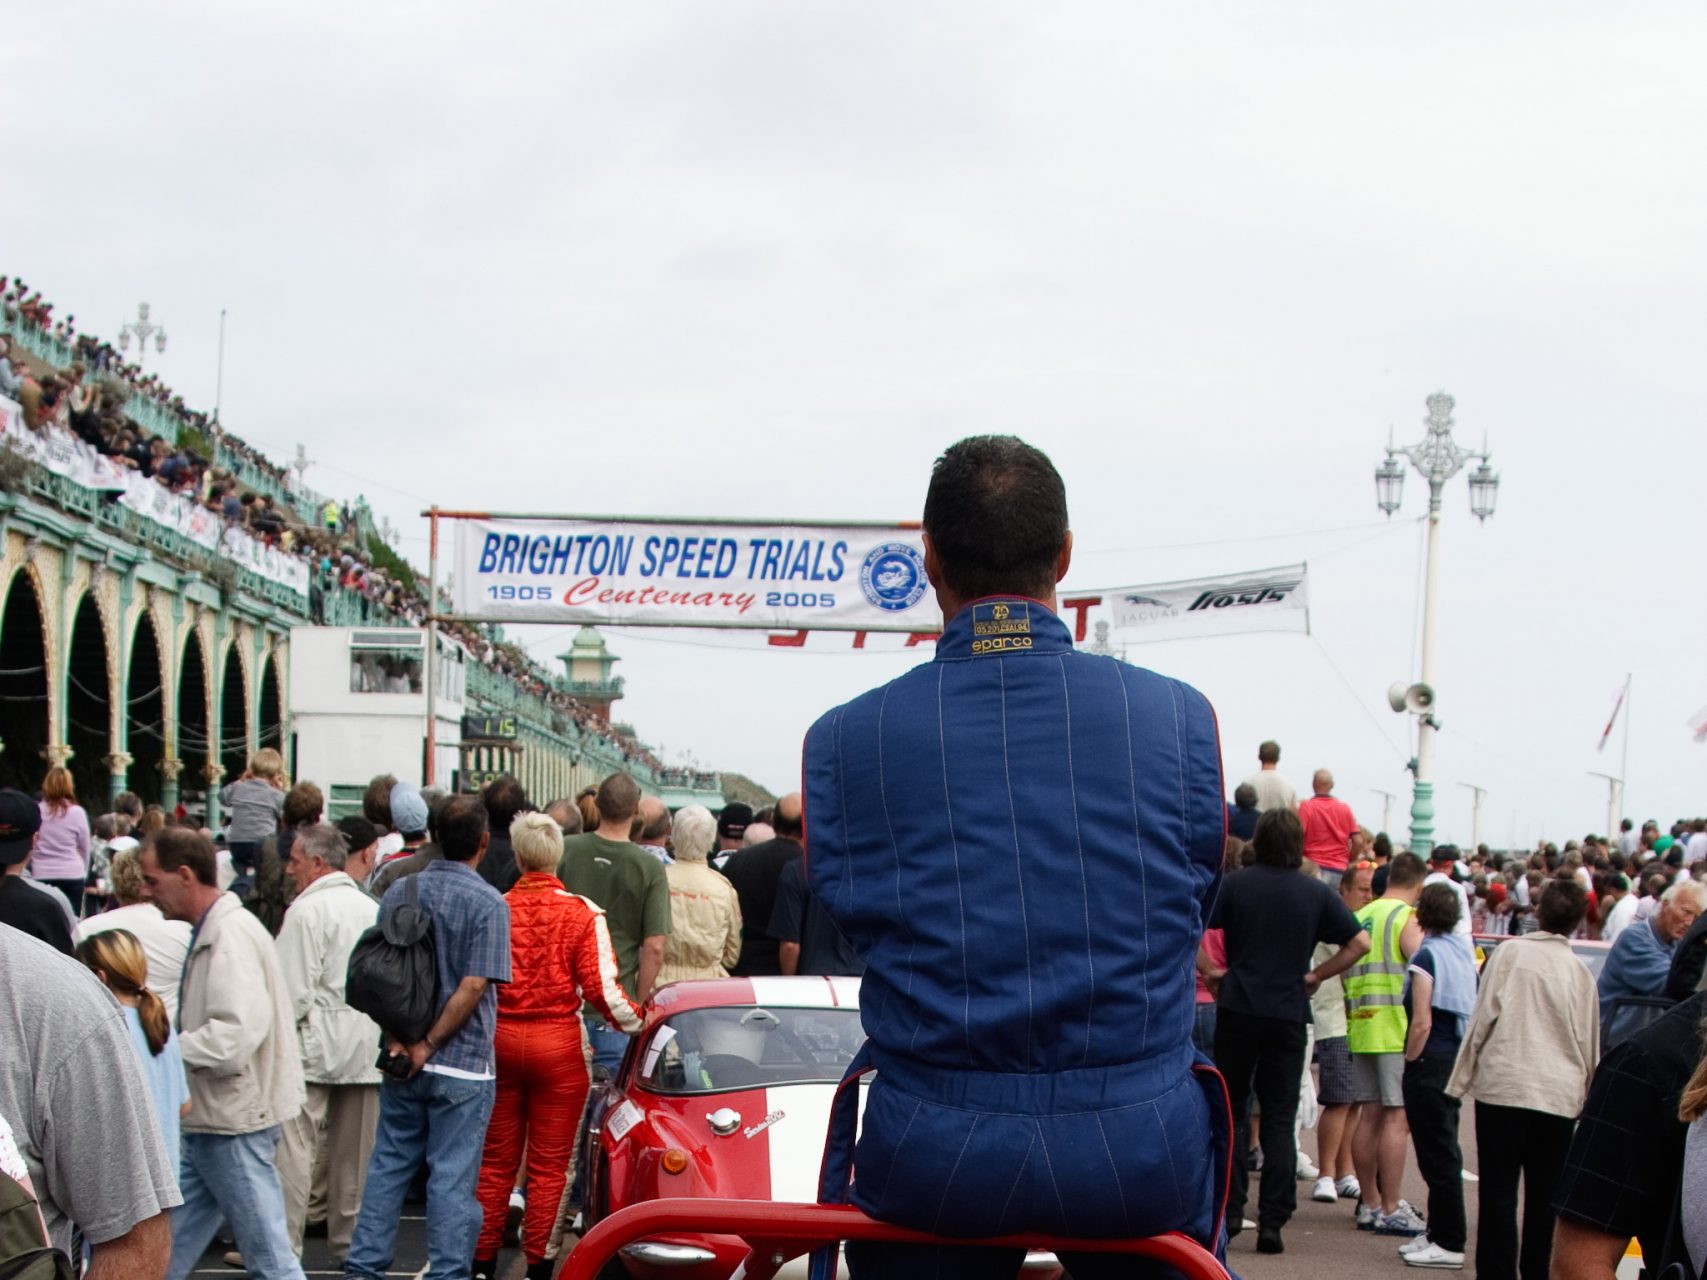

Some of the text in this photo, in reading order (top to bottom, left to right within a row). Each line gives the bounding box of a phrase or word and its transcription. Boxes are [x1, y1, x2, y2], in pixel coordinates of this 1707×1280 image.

[478, 532, 848, 582] BRIGHTON SPEED TRIALS
[487, 577, 836, 615] 1905 Centenary 2005
[1122, 610, 1179, 624] JAGUAR
